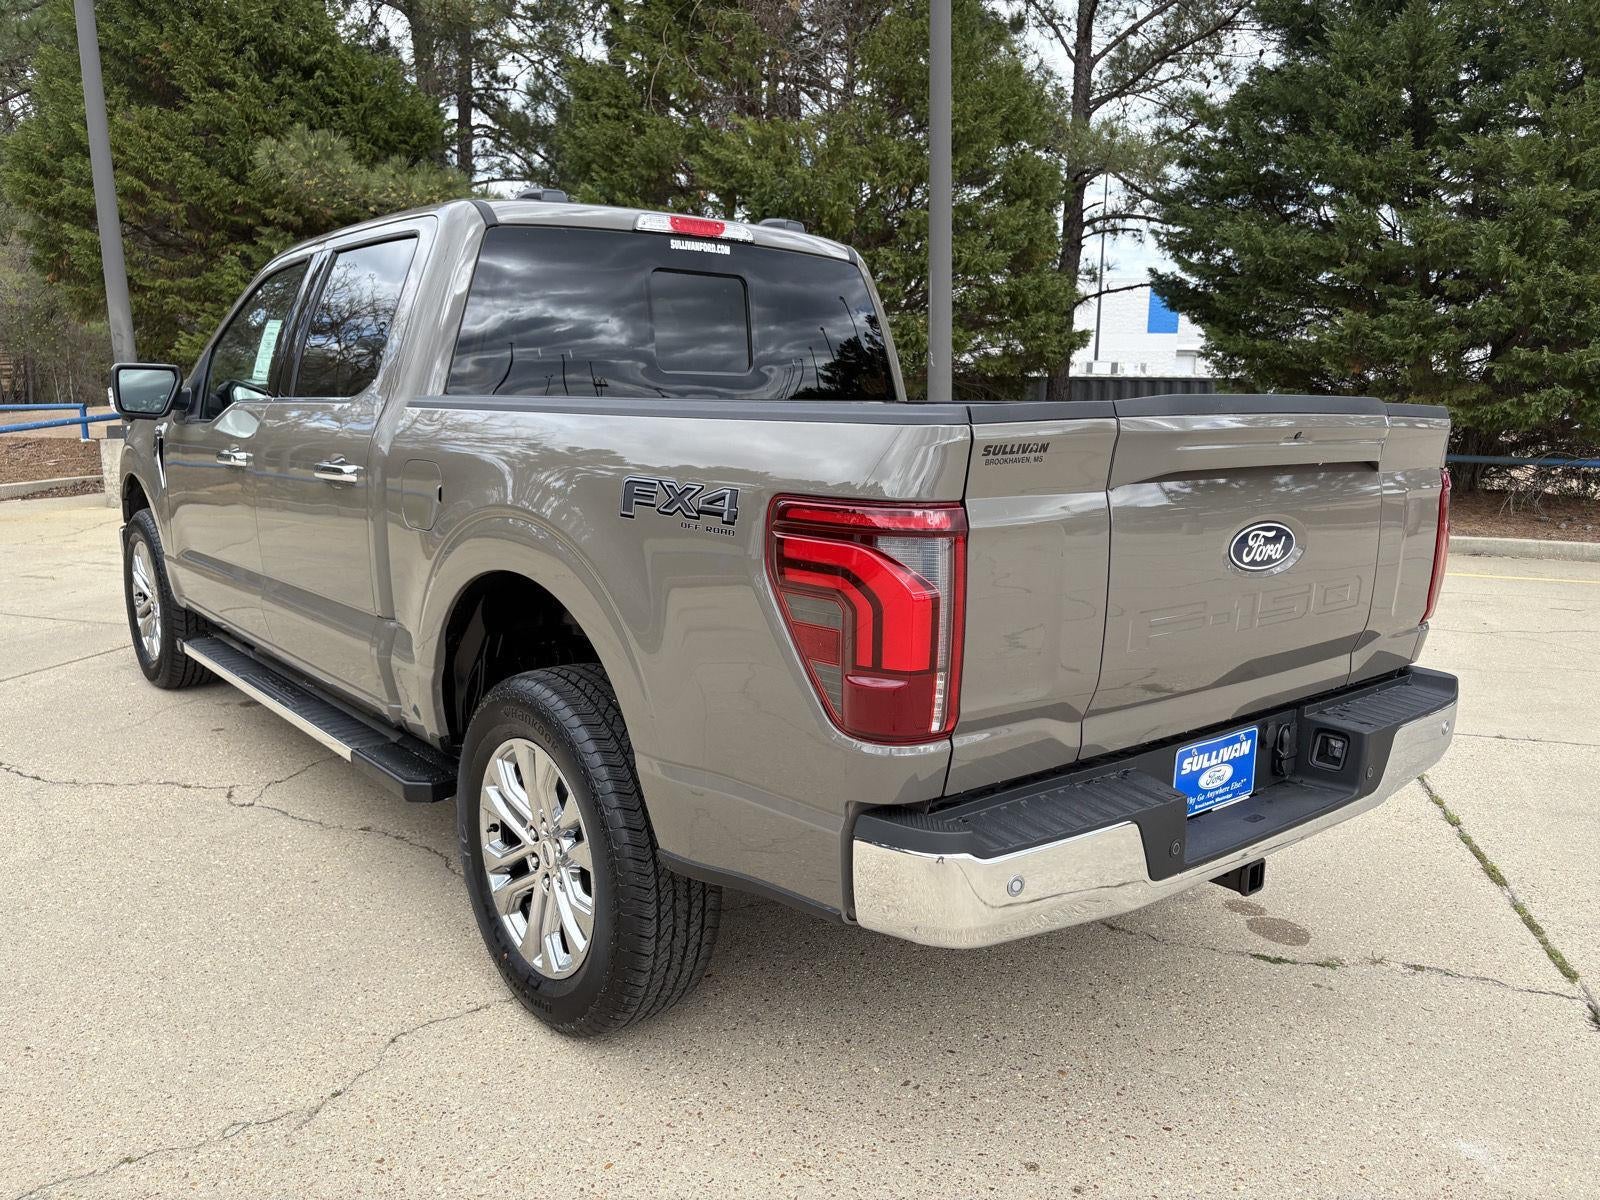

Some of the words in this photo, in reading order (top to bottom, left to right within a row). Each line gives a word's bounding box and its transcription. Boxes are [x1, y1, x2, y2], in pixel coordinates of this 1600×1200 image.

[670, 239, 731, 255] SULLIVANFORD.COM
[981, 442, 1050, 457] SULLIVAN
[984, 456, 1032, 466] BROOKHAVEN,
[620, 475, 739, 526] FX4
[680, 521, 701, 531] OFF
[705, 525, 735, 537] ROAD
[1242, 530, 1285, 563] Ford
[1126, 575, 1362, 654] F-150
[1181, 739, 1252, 775] SULLIVAN
[1206, 768, 1226, 786] Ford
